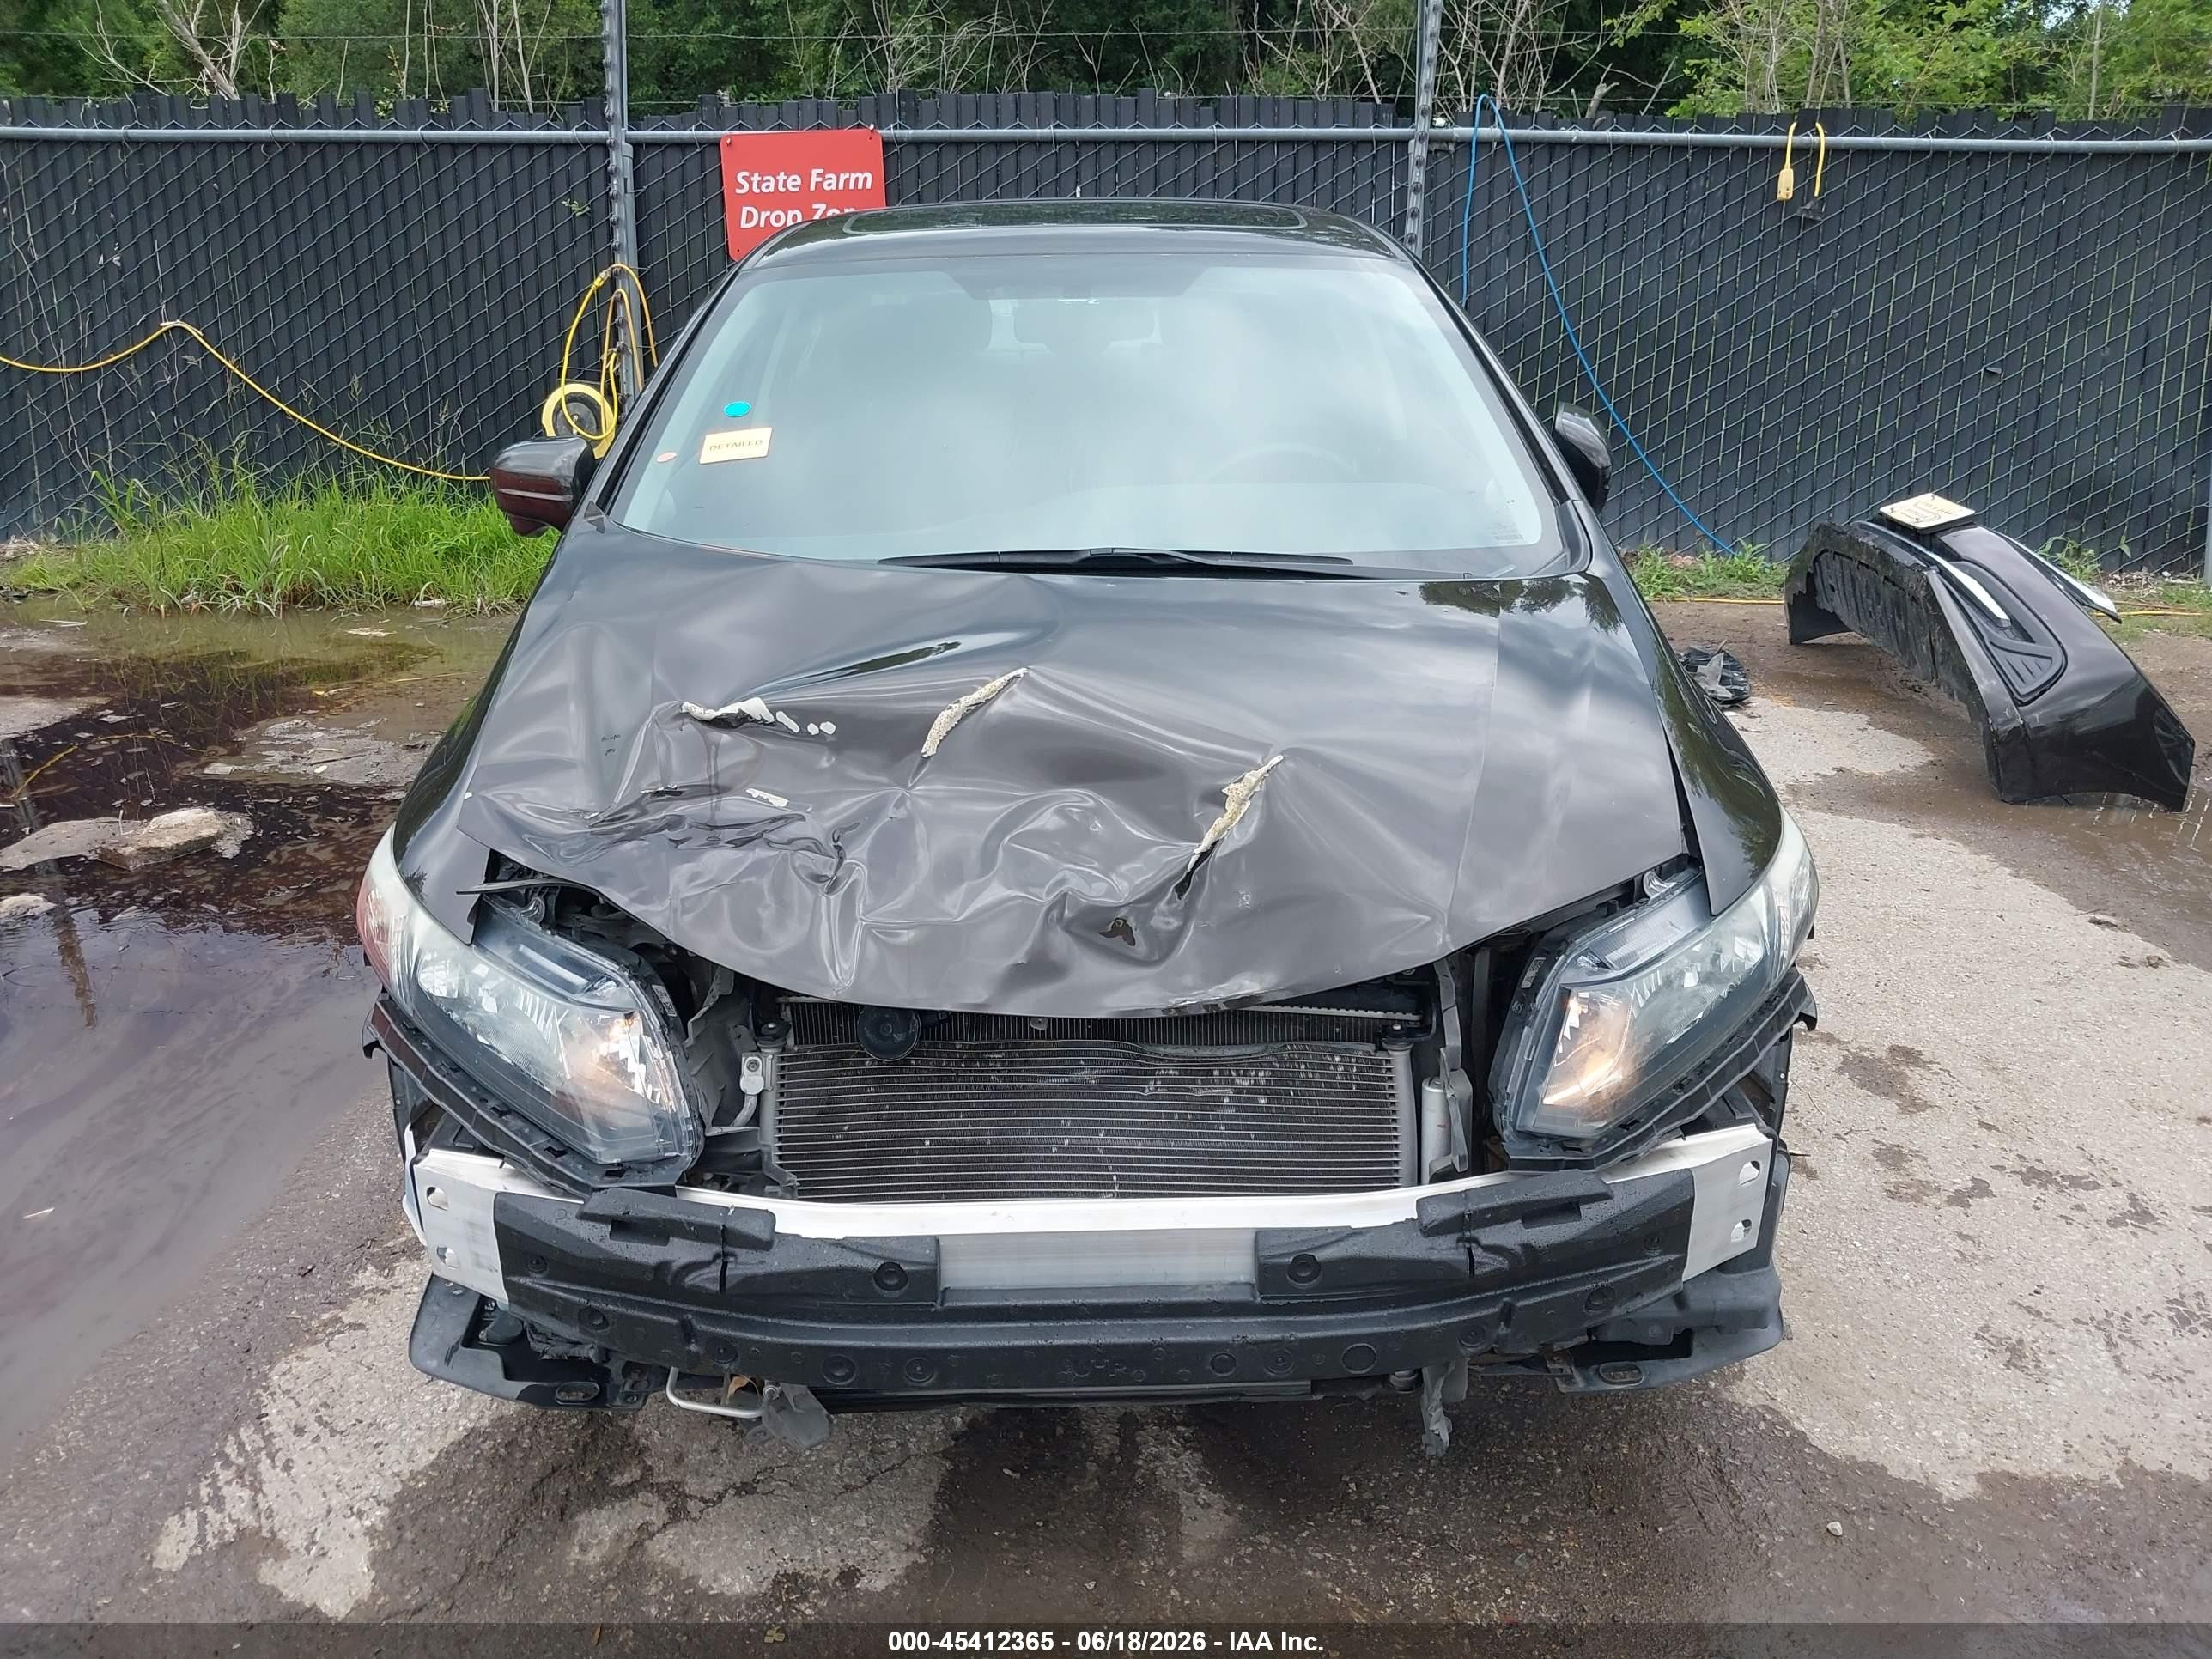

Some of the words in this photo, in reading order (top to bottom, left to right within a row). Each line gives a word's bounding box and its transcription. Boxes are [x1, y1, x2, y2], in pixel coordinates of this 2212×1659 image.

[735, 171, 802, 194] State
[810, 168, 873, 191] Farm
[709, 439, 763, 451] DETAILED
